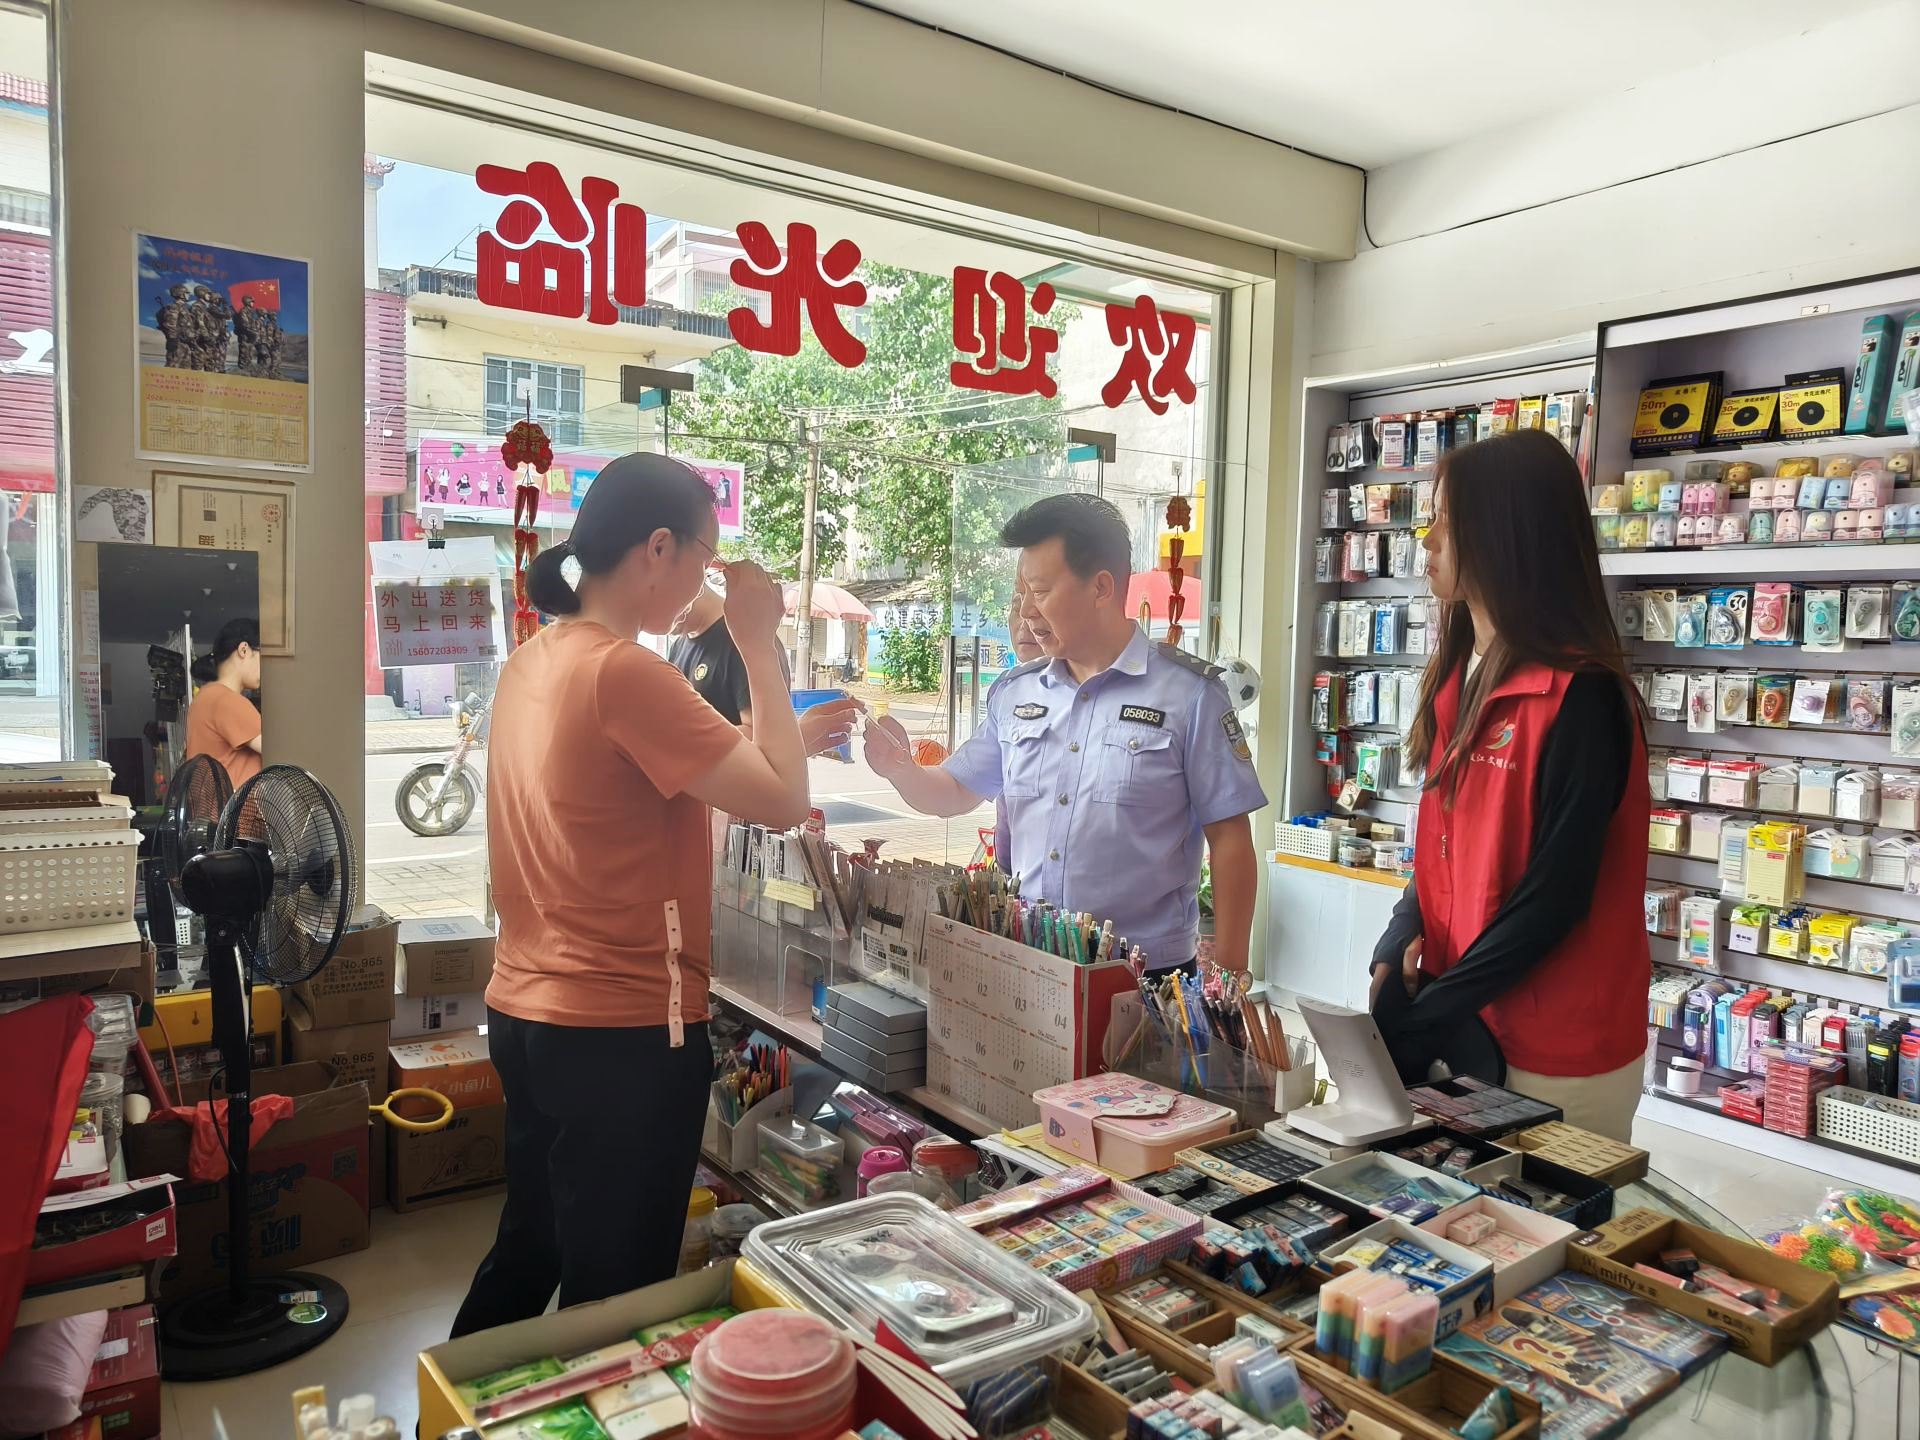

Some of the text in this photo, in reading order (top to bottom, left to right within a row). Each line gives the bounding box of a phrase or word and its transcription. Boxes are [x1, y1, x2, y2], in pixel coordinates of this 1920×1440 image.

[1641, 400, 1666, 411] 50m
[381, 590, 487, 608] 外出送货
[383, 613, 488, 633] 马上回来
[1123, 707, 1160, 723] 058033
[340, 956, 384, 970] No.965
[943, 969, 953, 983] 01
[977, 982, 988, 996] 02
[1014, 996, 1027, 1012] 03
[1054, 1013, 1067, 1030] 04
[940, 1025, 951, 1040] 05
[975, 1041, 986, 1056] 06
[331, 1052, 375, 1066] No.965
[1013, 1058, 1025, 1073] 07
[940, 1082, 951, 1095] 09
[975, 1100, 986, 1114] 10
[1600, 1266, 1637, 1292] miffy
